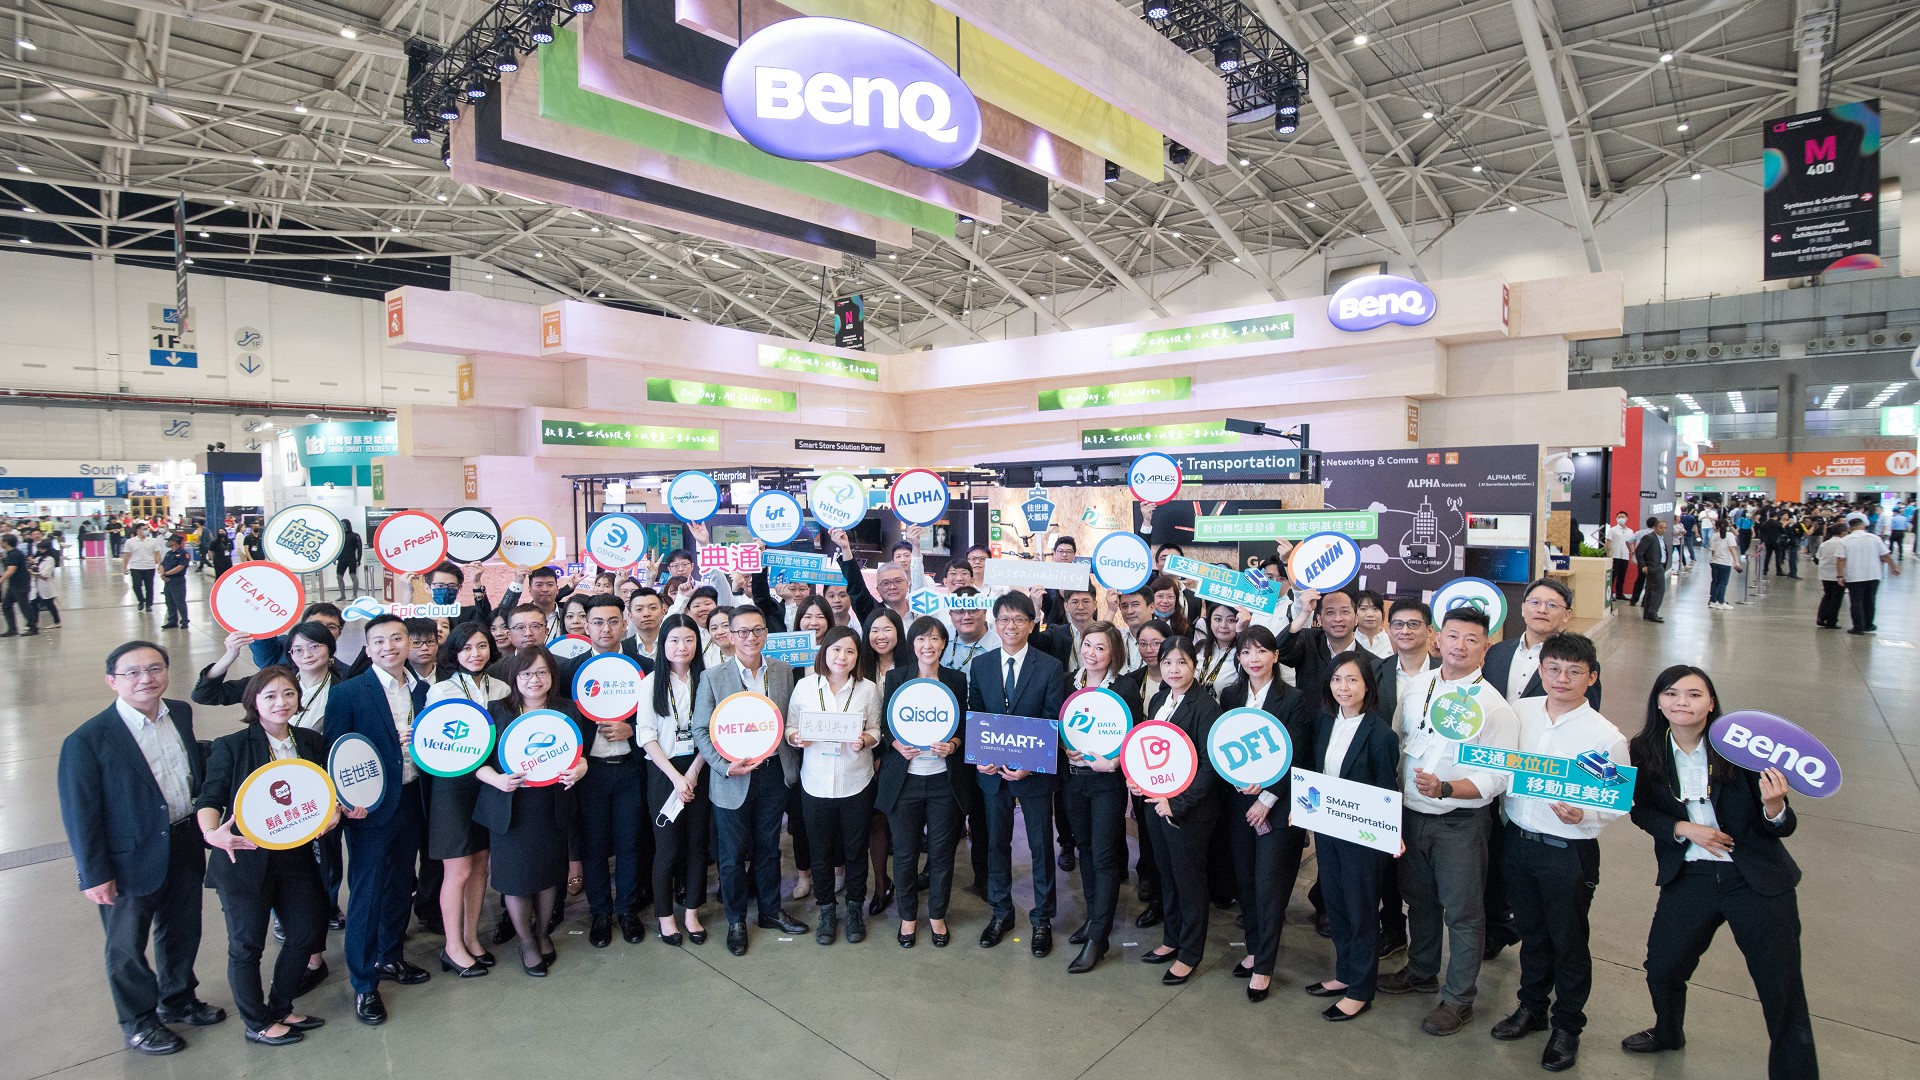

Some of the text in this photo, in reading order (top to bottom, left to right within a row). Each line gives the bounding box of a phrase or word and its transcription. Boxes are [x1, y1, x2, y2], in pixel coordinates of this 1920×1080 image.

[756, 65, 959, 143] BenQ
[1805, 135, 1836, 164] M
[1806, 162, 1835, 175] 400
[1783, 200, 1815, 210] Systems
[1822, 194, 1859, 204] Solutions
[1796, 220, 1846, 232] International
[1792, 230, 1831, 239] Exhibitors
[1771, 249, 1801, 258] Internet
[1811, 243, 1852, 252] Everything
[1339, 286, 1426, 320] BenQ
[845, 311, 853, 323] N
[153, 333, 180, 349] 1F
[681, 388, 698, 398] One
[724, 390, 736, 401] All
[737, 392, 772, 404] Children
[1066, 393, 1081, 402] One
[1107, 390, 1120, 400] All
[1121, 386, 1161, 397] Children
[799, 440, 882, 452] Smart Store Solution Partner
[79, 463, 125, 476] South
[1187, 455, 1295, 473] Transportation
[1326, 456, 1419, 467] Networking & Comms
[1685, 461, 1698, 472] M
[1894, 456, 1905, 469] M
[713, 470, 747, 482] Enterprise
[1407, 478, 1440, 488] ALPHA
[898, 489, 943, 507] ALPHA
[819, 501, 851, 520] hitron
[1027, 503, 1049, 512] 佳世達
[1027, 513, 1050, 522] 大艦隊
[1202, 520, 1368, 534] 數位轉型要發達 就來明基佳世達
[385, 529, 439, 559] La Fresh
[700, 544, 762, 574] 典通
[766, 554, 819, 568] 協助雲地整合
[1100, 555, 1147, 571] Grandsys
[1422, 558, 1443, 566] Cnter
[989, 566, 1085, 588] Sustainability
[1176, 558, 1233, 584] 交通數位化
[235, 574, 288, 617] TEA TOP
[1208, 582, 1269, 610] 移動更美好
[767, 637, 807, 650] 雲地整合
[780, 651, 817, 662] 企業數位
[899, 706, 949, 723] Qisda
[1440, 714, 1475, 738] 永續
[420, 737, 482, 756] MetaGuru
[980, 730, 1046, 749] SMART+
[1219, 725, 1281, 771] DFI
[1722, 722, 1827, 789] BenQ
[1470, 748, 1560, 775] 交通數位化
[339, 759, 380, 789] 佳世達
[1150, 772, 1176, 786] D8AI
[1525, 776, 1620, 806] 移動更美好
[1325, 794, 1361, 811] SMART
[269, 812, 320, 836] FORMOSA CHANG
[1325, 805, 1398, 833] Transportation
